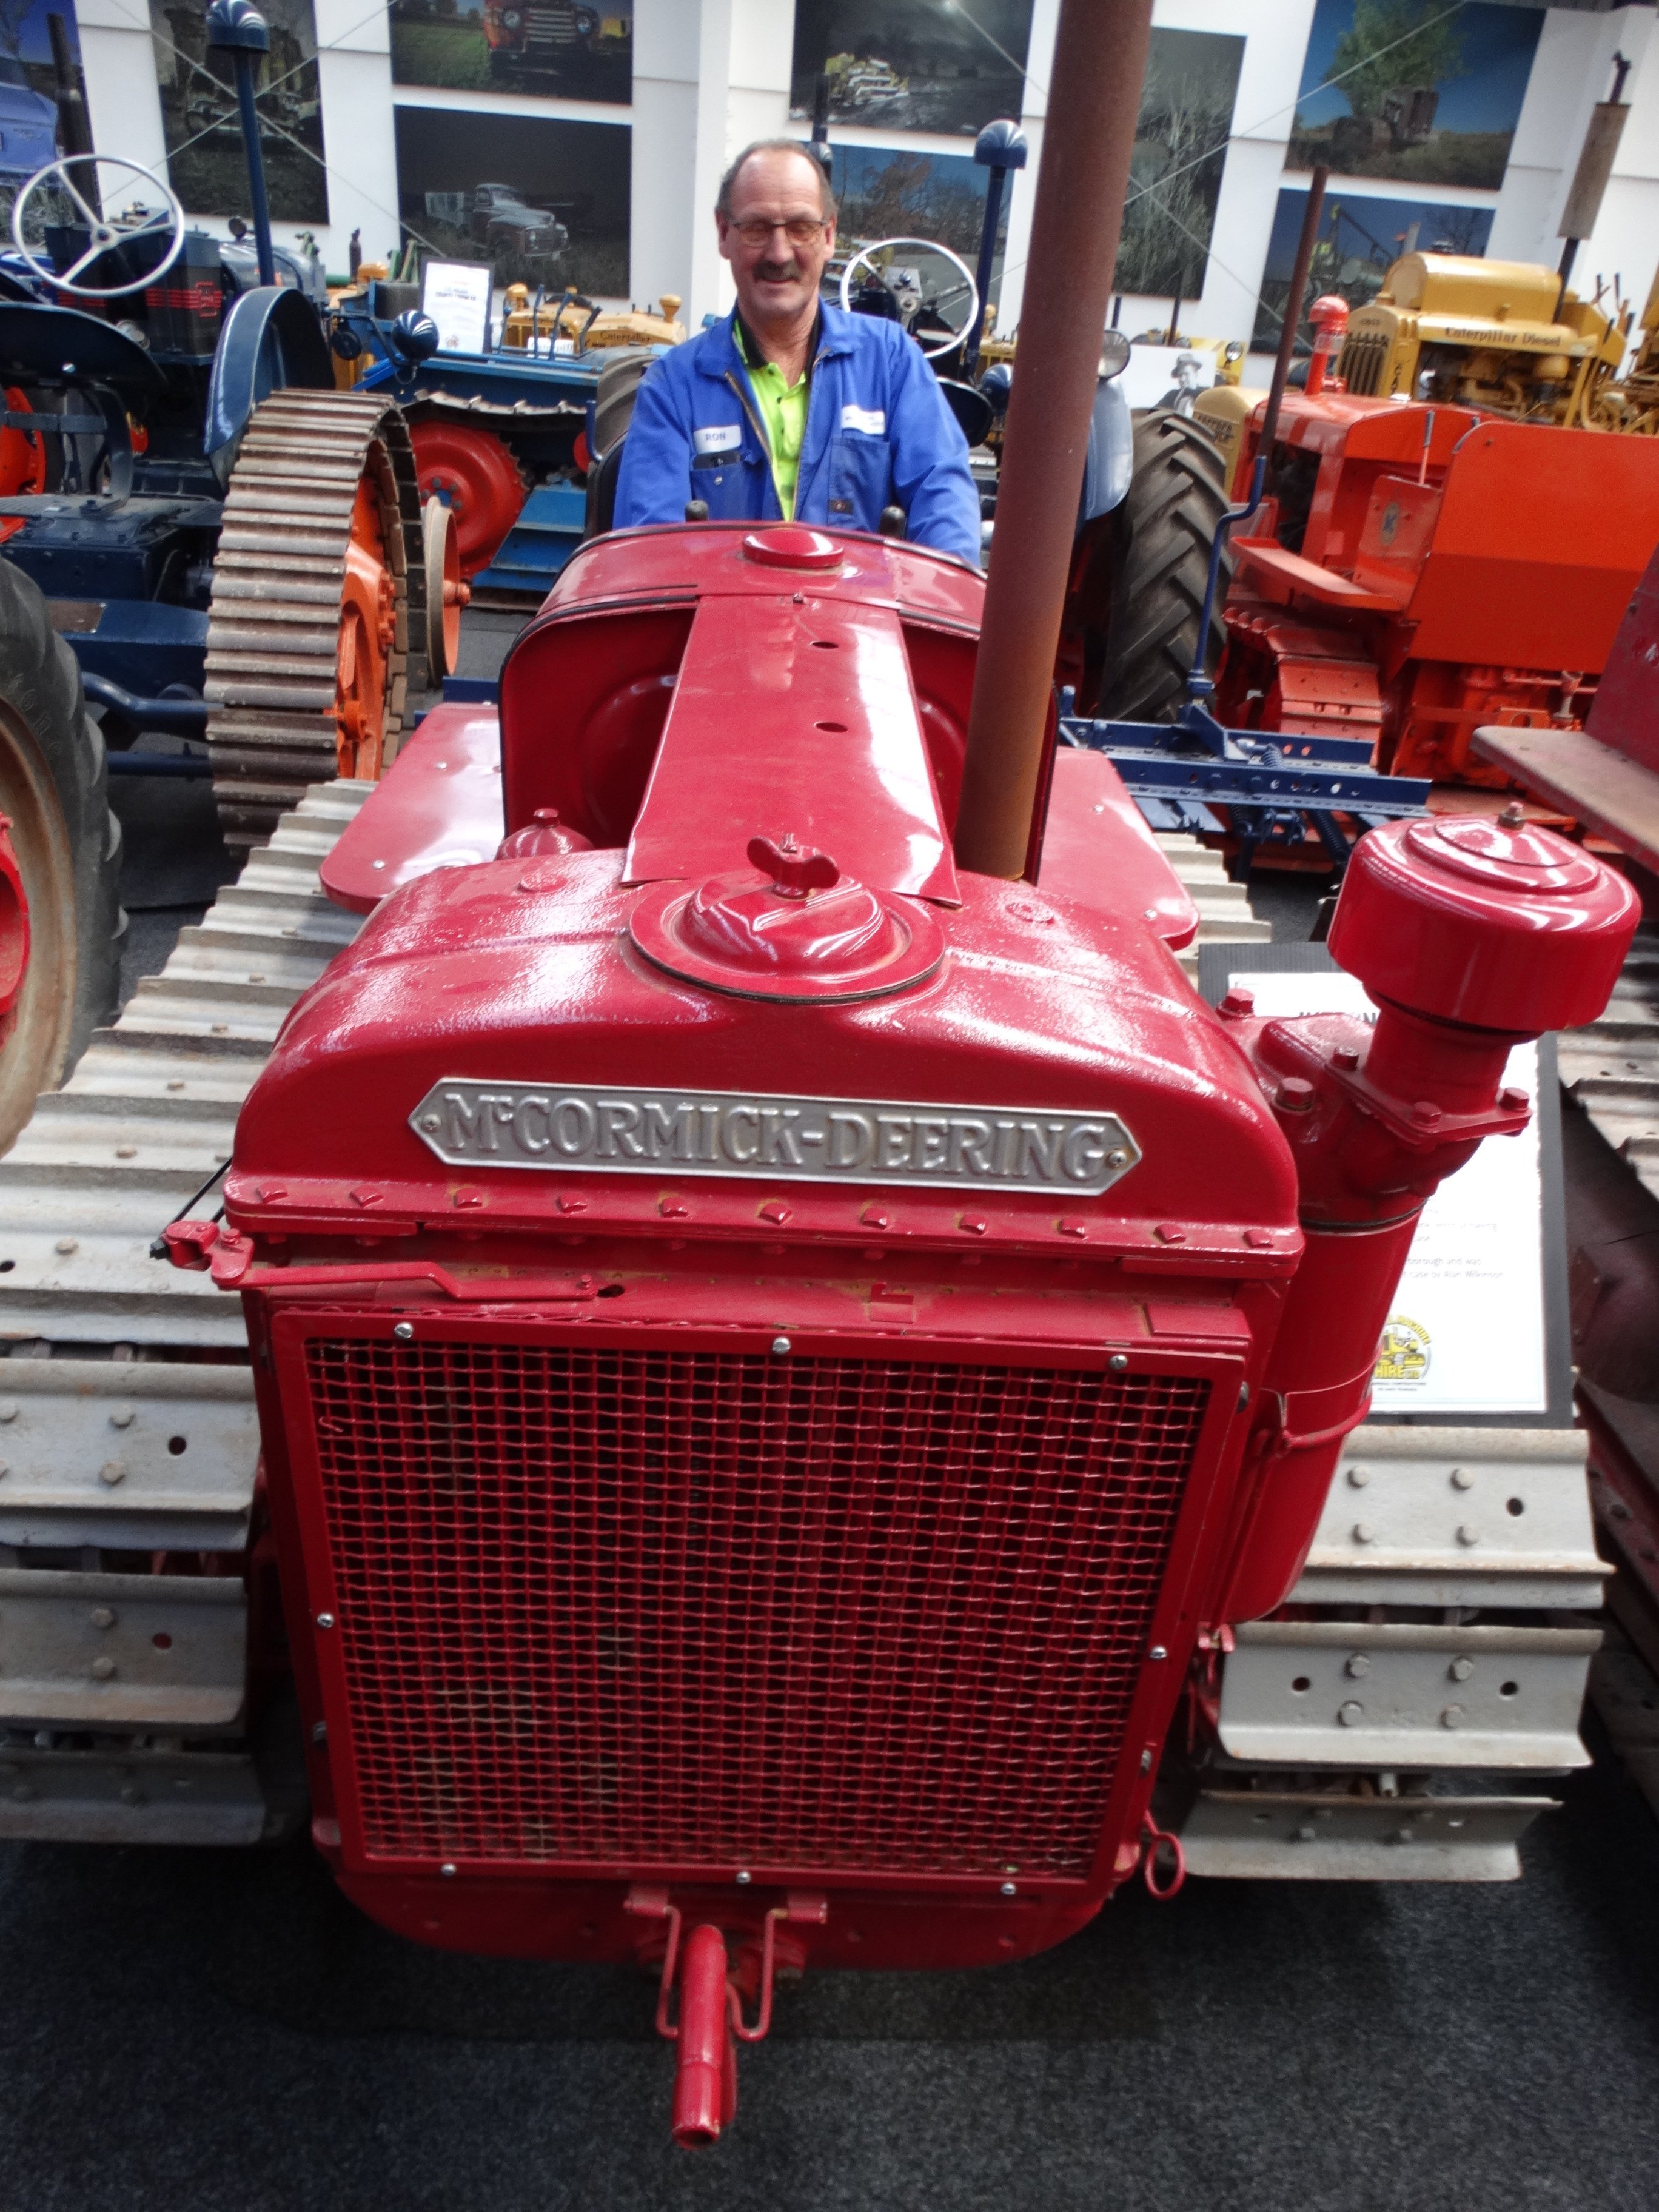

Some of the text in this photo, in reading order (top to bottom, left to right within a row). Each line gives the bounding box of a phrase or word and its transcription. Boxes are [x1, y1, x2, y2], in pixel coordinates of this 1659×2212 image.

[1444, 326, 1561, 346] Caterpillar Diesel
[705, 432, 727, 442] RON
[1375, 1364, 1404, 1379] HIRE
